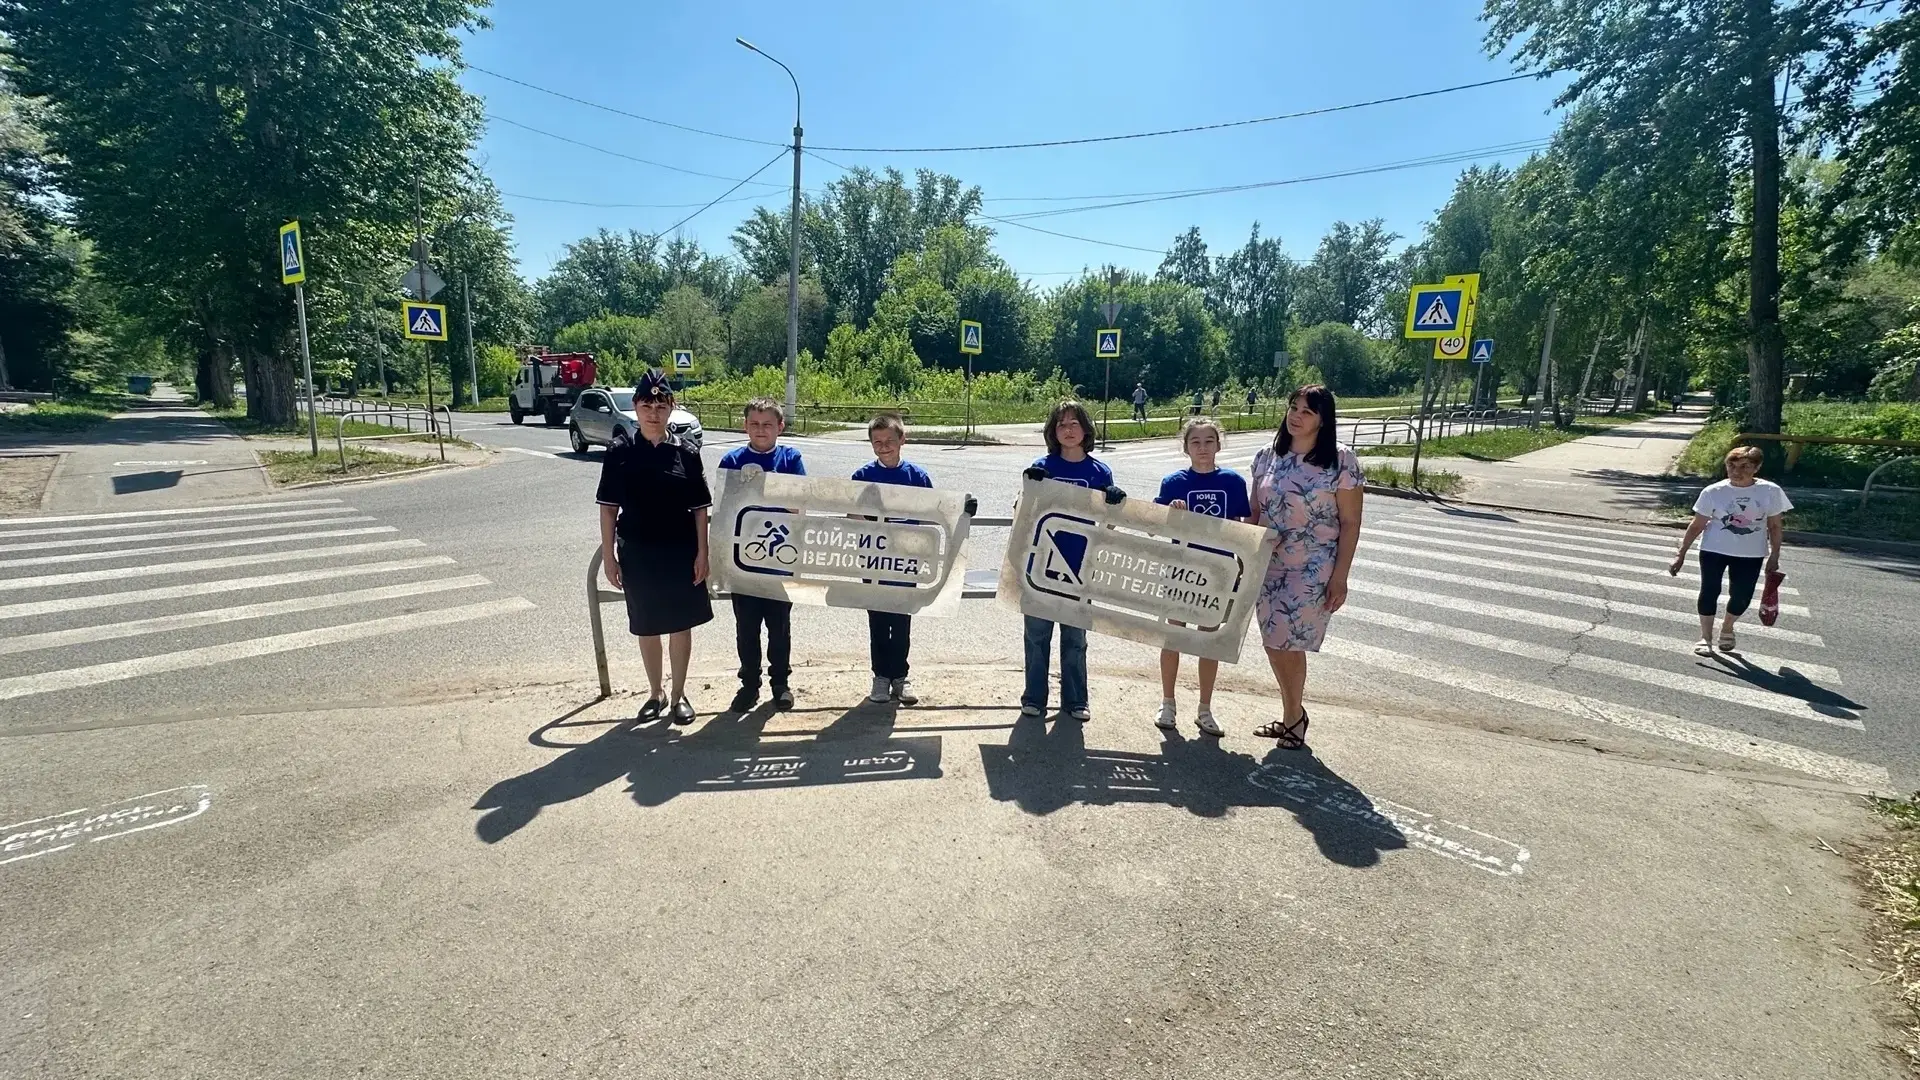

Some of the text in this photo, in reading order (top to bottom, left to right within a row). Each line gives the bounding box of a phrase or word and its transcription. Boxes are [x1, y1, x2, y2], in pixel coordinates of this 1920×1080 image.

[1444, 338, 1460, 348] 40
[1196, 493, 1217, 501] ЮИД
[803, 527, 887, 550] СОЙДИ С
[802, 551, 932, 576] ВЕЛОСИПЕДА
[1097, 549, 1208, 587] ОТВЛЕКИСЬ
[1092, 569, 1220, 611] ОТ ТЕЛЕФОНА
